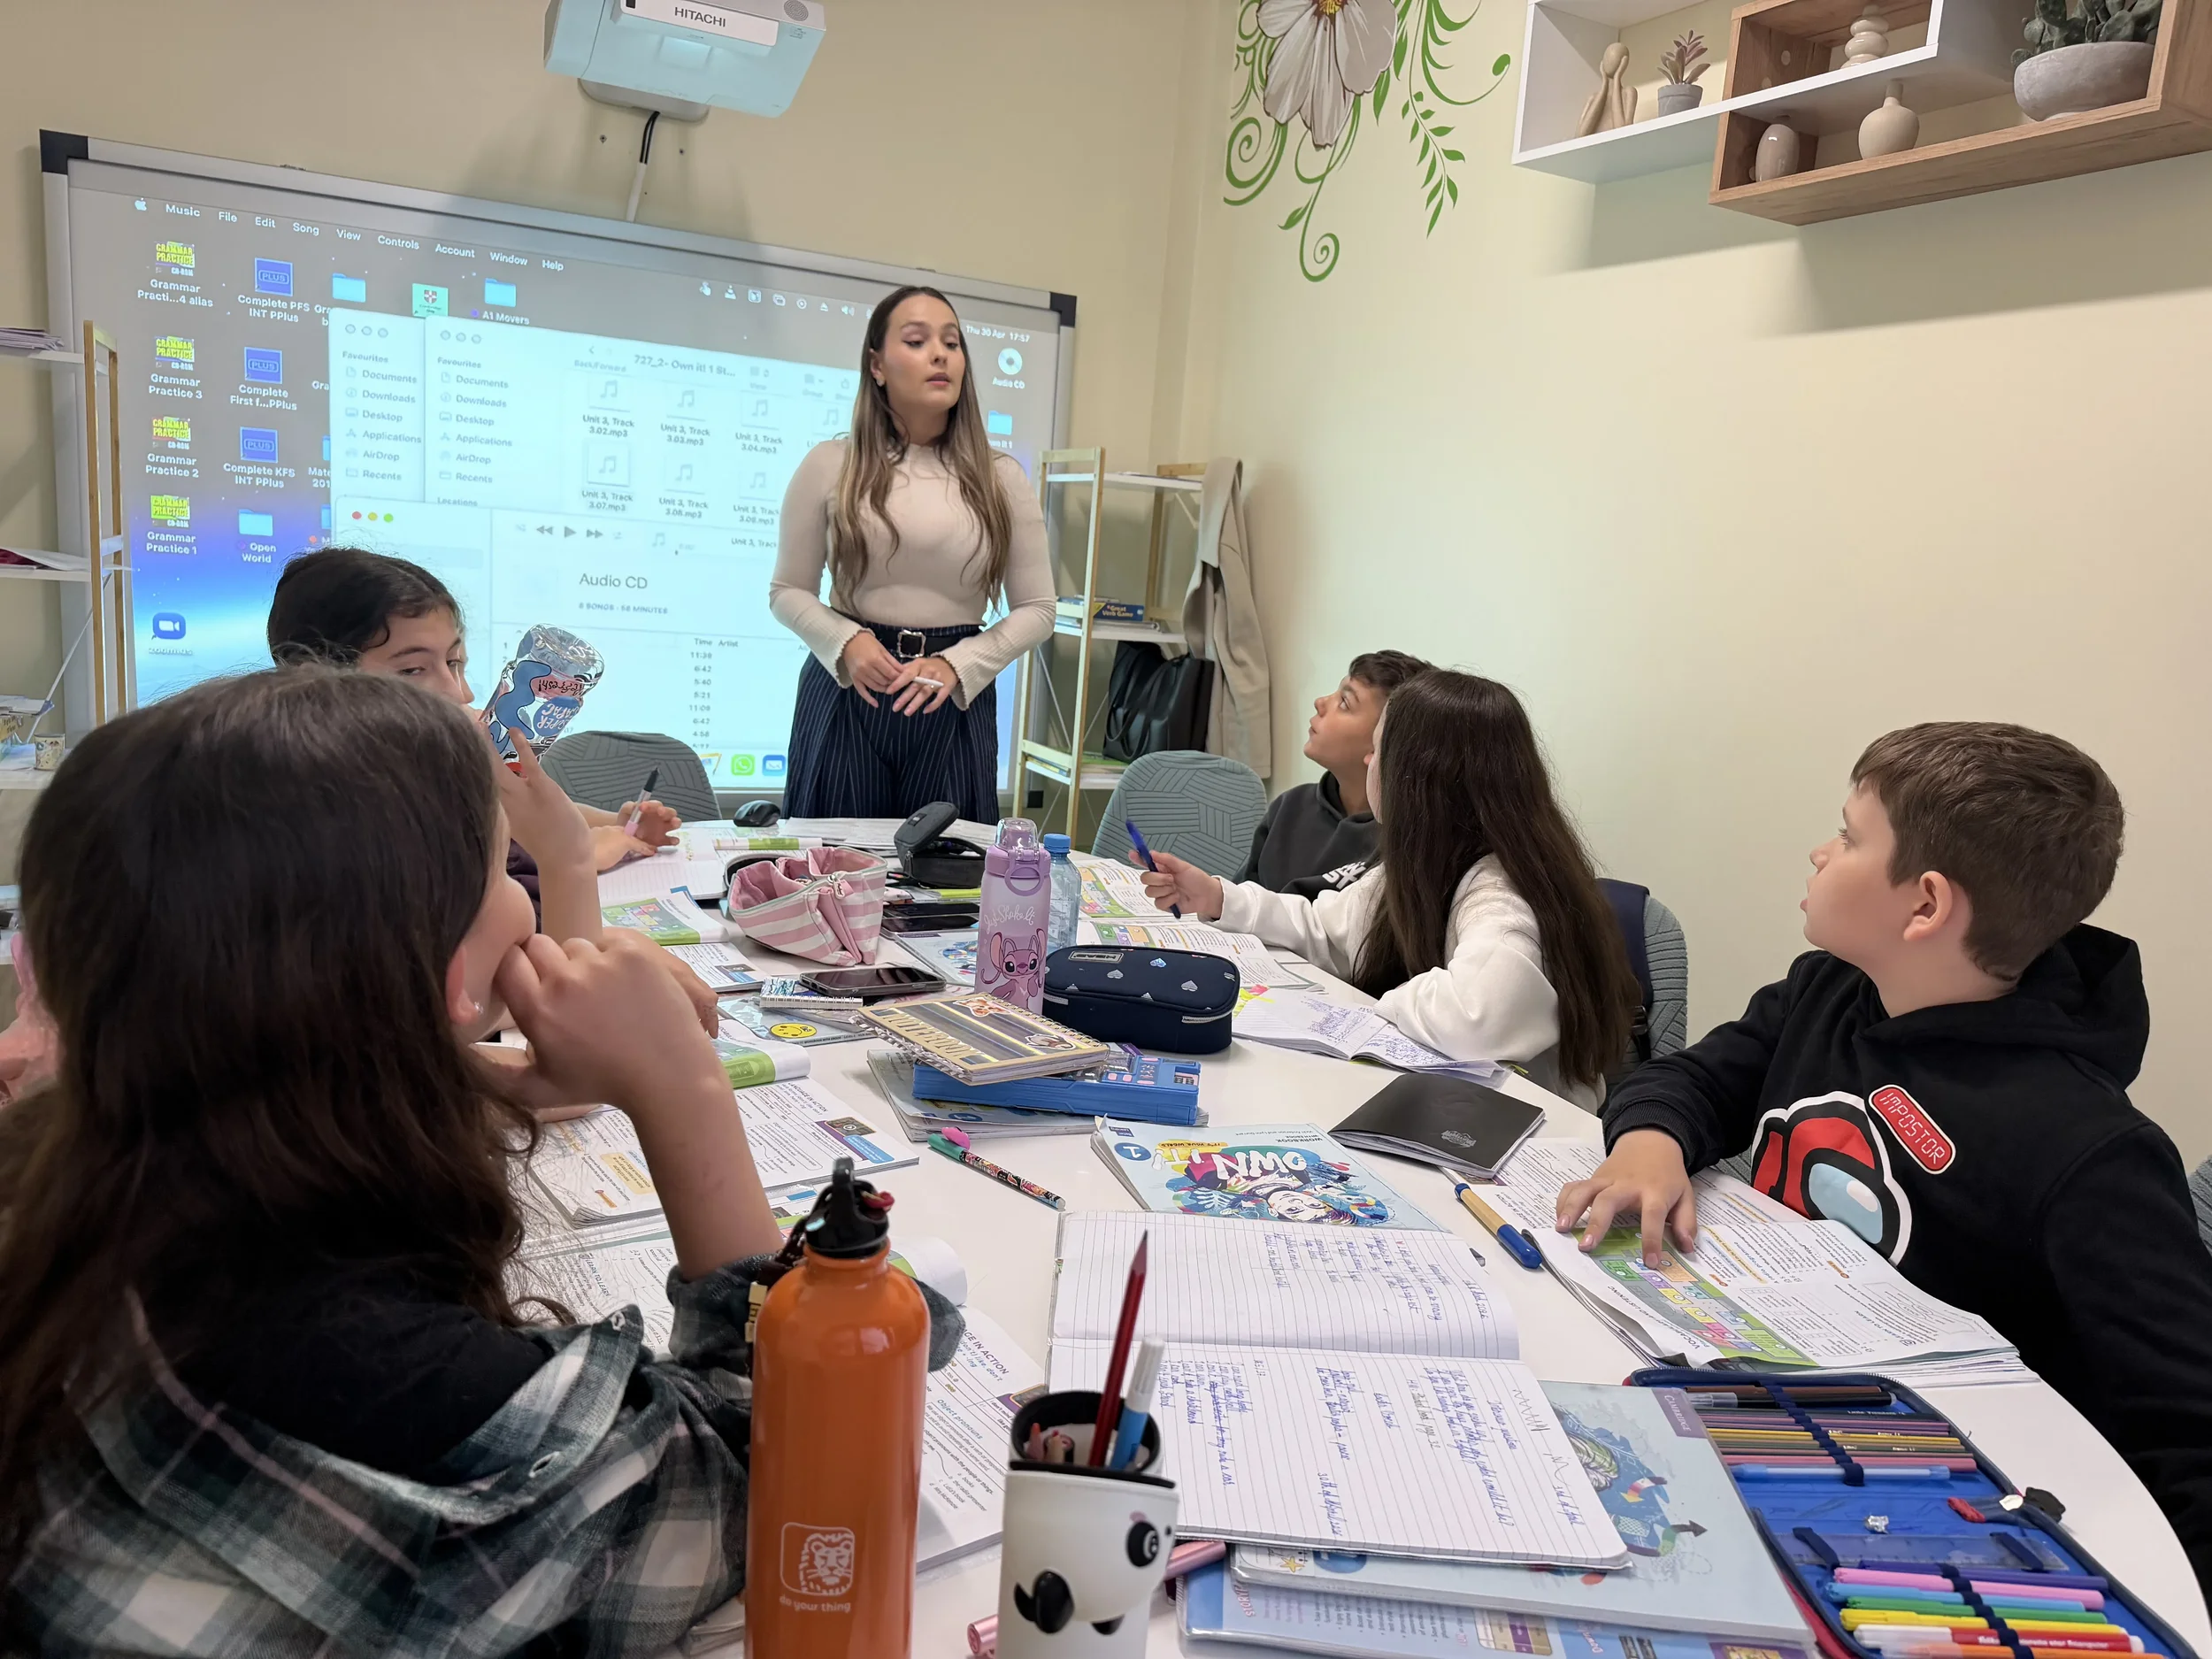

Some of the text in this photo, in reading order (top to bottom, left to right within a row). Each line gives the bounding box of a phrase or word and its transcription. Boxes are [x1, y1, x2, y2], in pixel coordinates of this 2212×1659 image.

[674, 7, 726, 27] HITACHI
[165, 204, 564, 272] Music File Edit Song View Controls Account Window Help
[156, 243, 193, 257] GRAMMAR
[156, 253, 193, 266] PRACTICE
[262, 273, 286, 283] PLUS
[150, 279, 200, 294] Grammar
[188, 296, 213, 307] alias
[238, 296, 310, 311] Complete PFS
[250, 308, 299, 323] INT PPlus
[483, 311, 530, 325] A1 Movers
[1010, 333, 1030, 342] 17:57
[156, 339, 192, 351] GRAMMAR
[156, 348, 193, 361] PRACTICE
[342, 352, 388, 363] Favourites
[251, 361, 274, 372] PLUS
[438, 357, 481, 369] Favourites
[672, 361, 695, 372] Own
[150, 373, 200, 388] Grammar
[363, 371, 417, 384] Documents
[457, 375, 509, 388] Documents
[993, 377, 1025, 388] Audio CD
[149, 386, 203, 399] Practice 3
[239, 385, 288, 400] Complete
[363, 390, 415, 403] Downloads
[230, 396, 253, 407] First
[457, 395, 507, 408] Downloads
[363, 410, 403, 422] Desktop
[456, 414, 495, 426] Desktop
[583, 415, 634, 427] Unit Track
[153, 419, 188, 429] GRAMMAR
[661, 424, 710, 436] Unit Track
[153, 428, 189, 439] PRACTICE
[363, 430, 421, 443] Applications
[589, 426, 628, 438] 3.02.mp3
[457, 434, 512, 447] Applications
[667, 435, 703, 447] 3.03.mp3
[735, 432, 782, 446] Unit Track
[148, 453, 196, 465] Grammar
[363, 450, 399, 462] AirDrop
[457, 454, 491, 465] AirDrop
[146, 465, 198, 478] Practice 2
[224, 463, 273, 475] Complete
[363, 470, 402, 480] Recents
[235, 475, 284, 488] INT PPlus
[457, 472, 492, 484] Recents
[152, 498, 188, 507] GRAMMAR
[437, 497, 478, 507] Locations
[582, 490, 633, 503] Unit Track
[589, 502, 626, 512] 3.07.mp3
[659, 497, 708, 510] Unit Track
[733, 504, 750, 514] Unit
[153, 506, 188, 517] PRACTICE
[148, 532, 196, 543] Grammar
[146, 543, 189, 554] Practice
[250, 542, 276, 553] Open
[242, 553, 271, 563] World
[580, 573, 648, 589] Audio CD
[998, 904, 1025, 923] Shake
[1879, 1092, 1945, 1164] IMPOSTOR
[1123, 1147, 1142, 1158] 1
[1211, 1150, 1307, 1180] OWN
[981, 1350, 1009, 1374] ACTION
[1664, 1394, 1691, 1432] CAMBRIDGE
[937, 1399, 983, 1440] Object pronouns
[780, 1594, 851, 1613] do your thing
